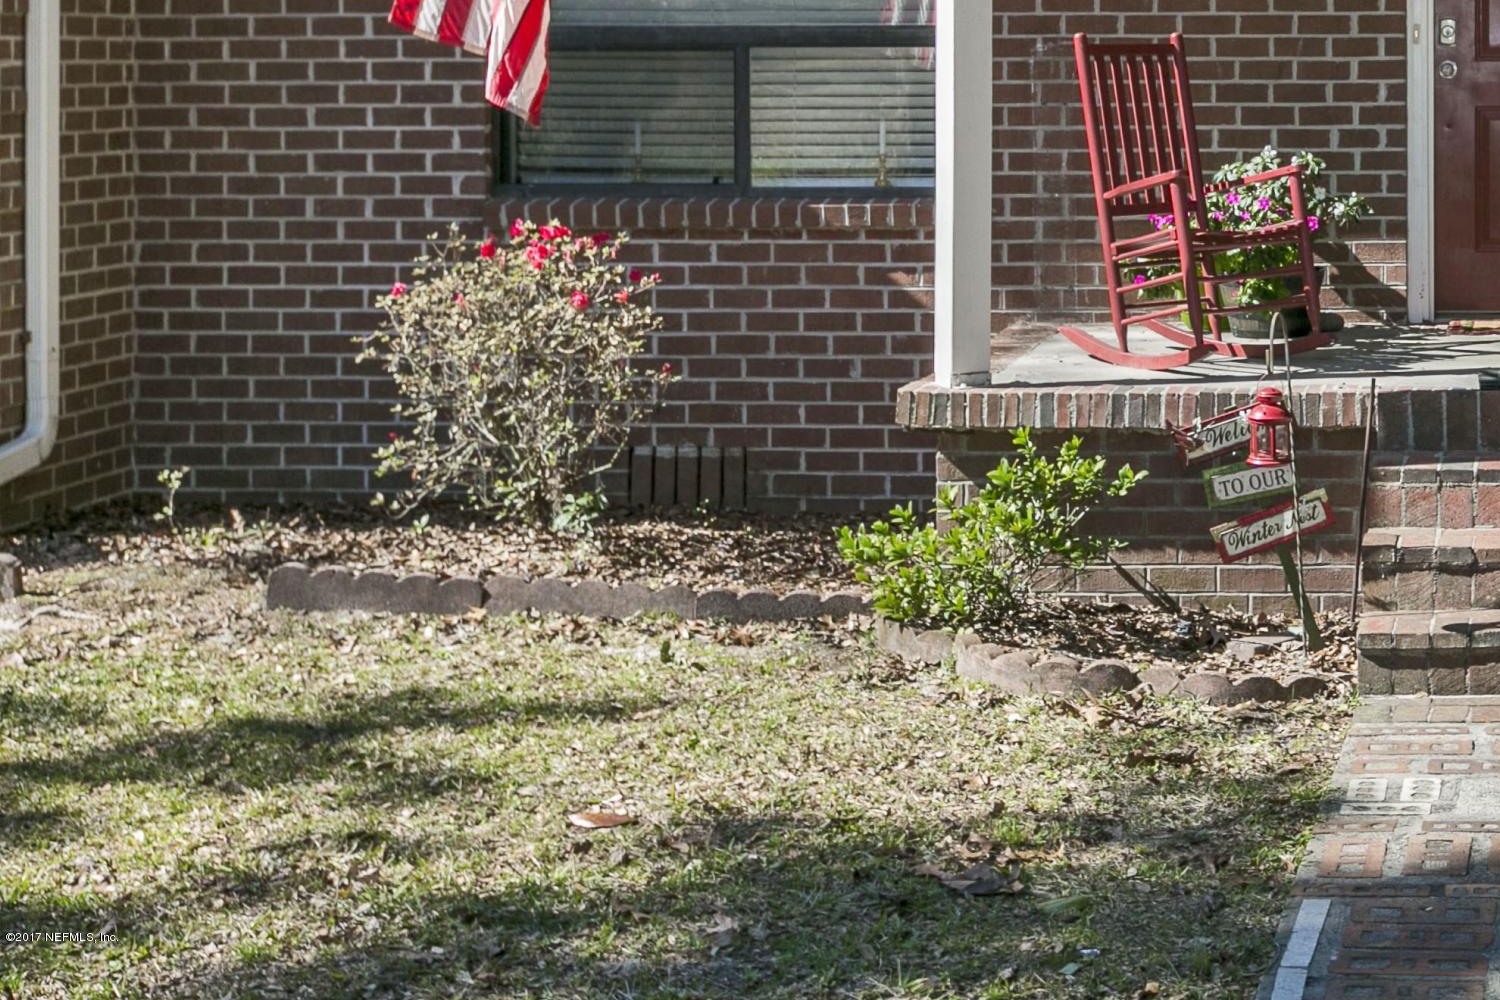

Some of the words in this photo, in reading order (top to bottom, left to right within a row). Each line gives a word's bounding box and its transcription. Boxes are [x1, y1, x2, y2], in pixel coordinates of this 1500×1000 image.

[1206, 421, 1254, 447] Welc
[1218, 478, 1243, 497] TO
[1249, 468, 1288, 490] OUR
[1228, 521, 1284, 550] Winter
[1286, 504, 1320, 530] Nest
